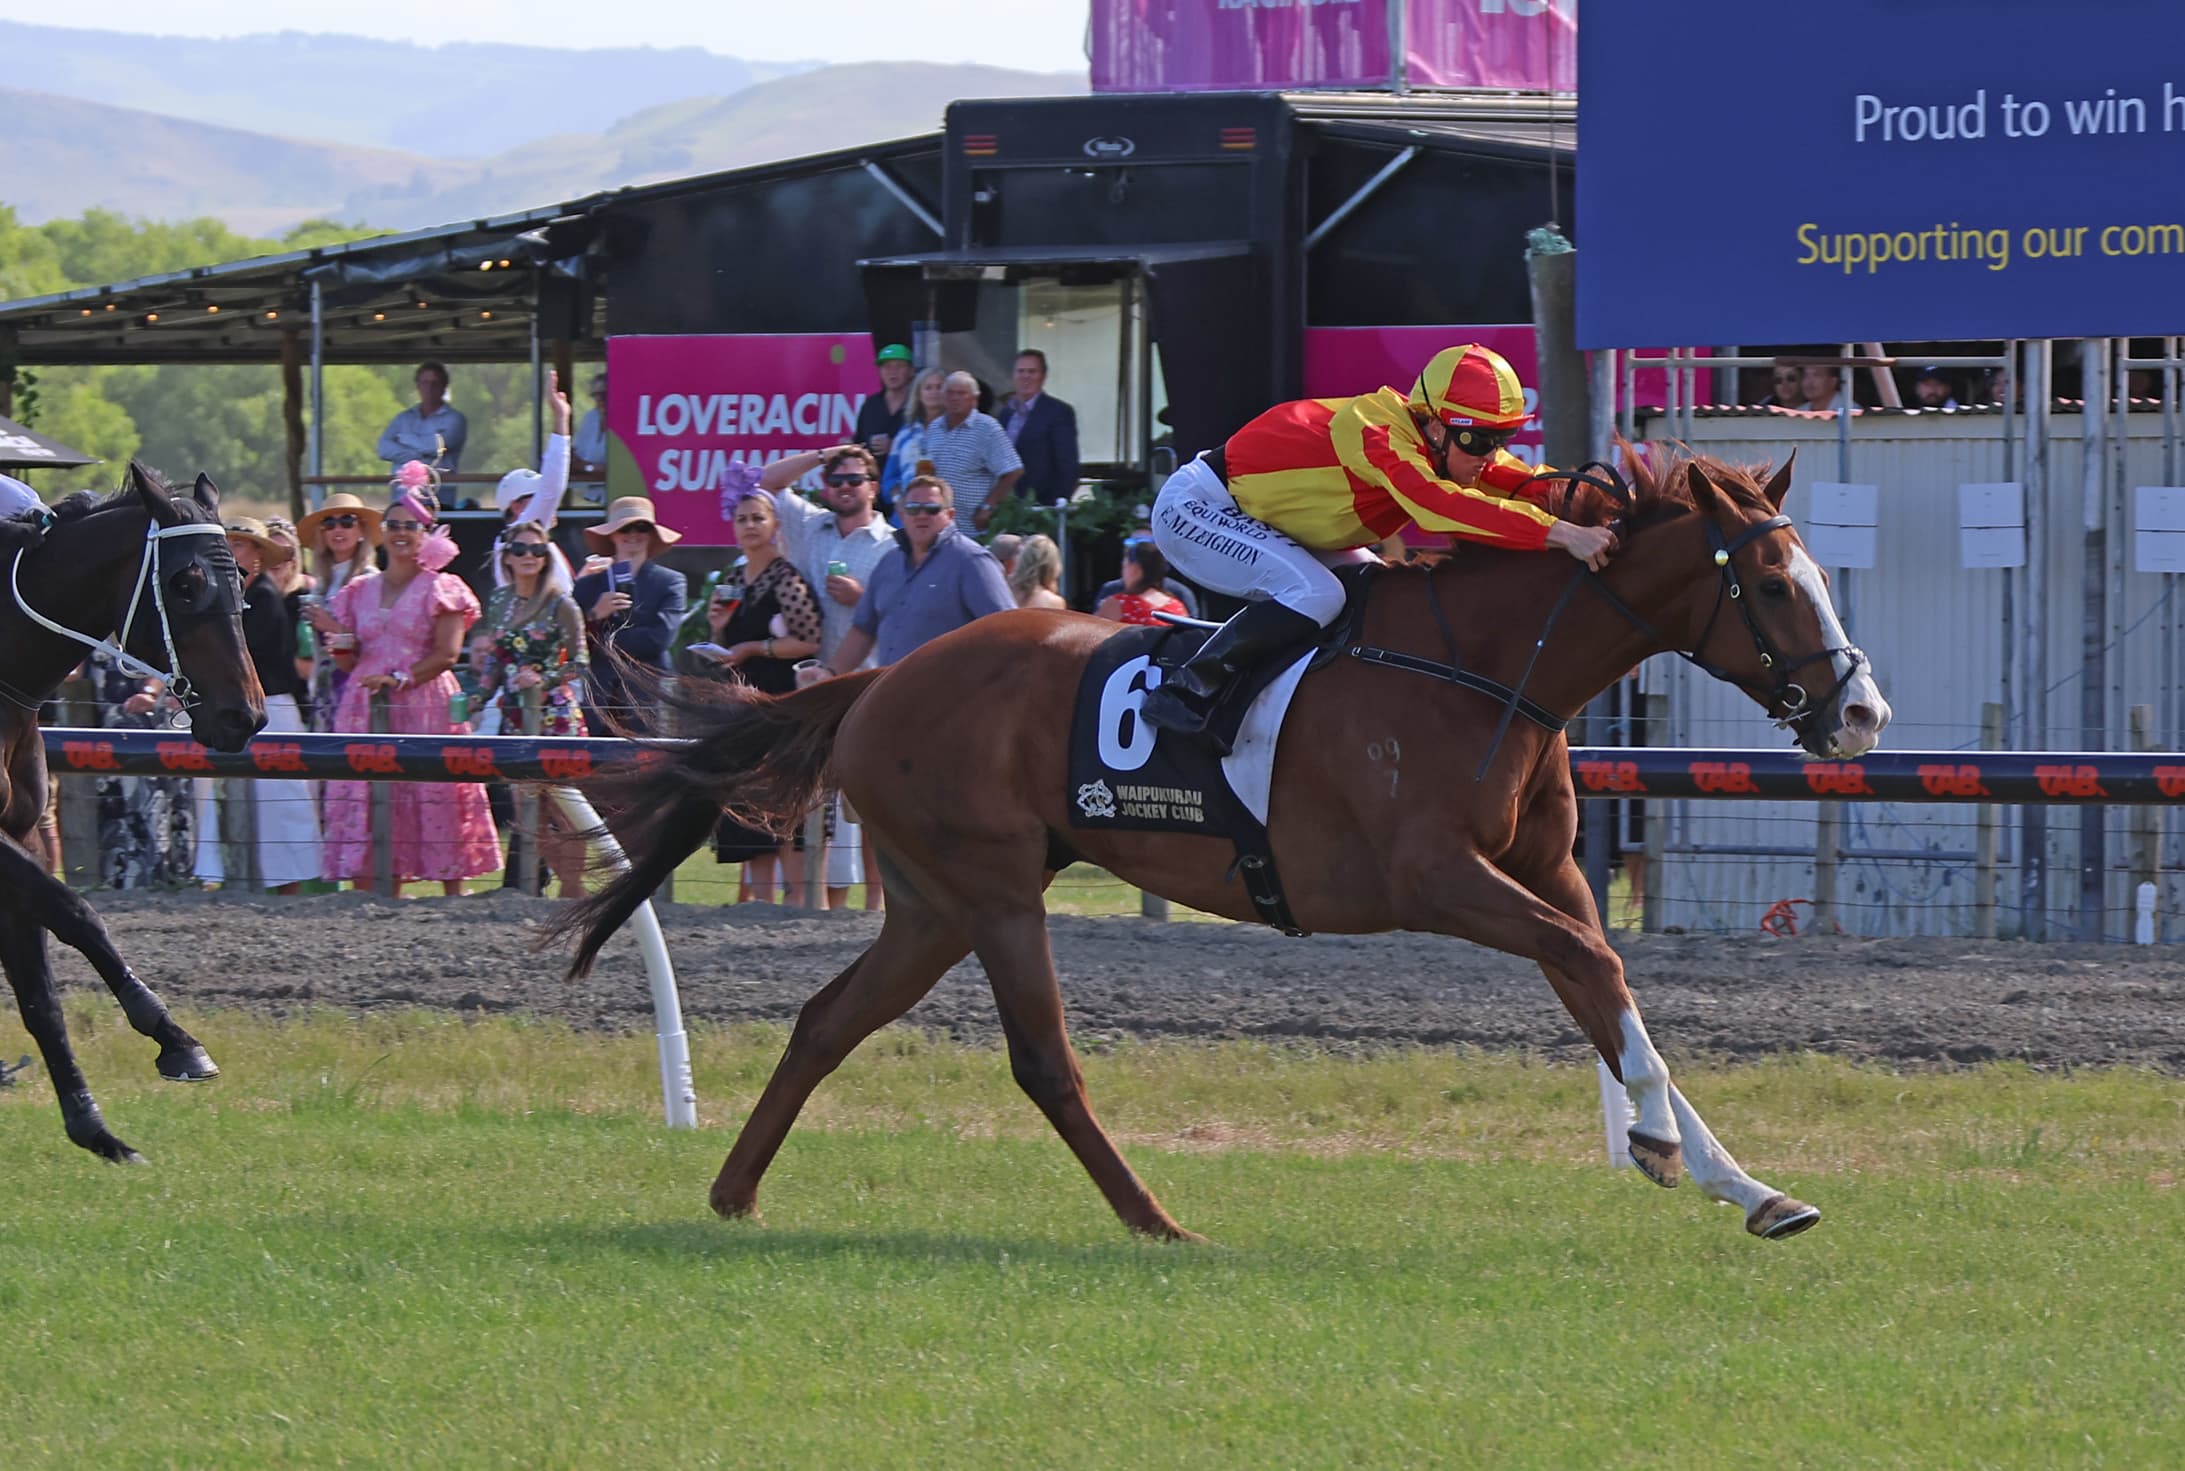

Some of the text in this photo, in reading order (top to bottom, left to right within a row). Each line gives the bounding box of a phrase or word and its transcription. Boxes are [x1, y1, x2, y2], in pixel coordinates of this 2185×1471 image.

[1854, 88, 1987, 143] Proud
[2001, 93, 2051, 138] to
[2064, 88, 2147, 135] win
[1796, 221, 2185, 275] Supporting our com
[1184, 498, 1269, 541] EQUIWORLD
[1098, 654, 1162, 771] 6
[344, 744, 404, 773] TAB
[442, 746, 502, 776] TAB
[1576, 761, 1648, 792] TAB
[1688, 762, 1760, 793] TAB
[1802, 763, 1875, 794] TAB
[1916, 764, 1993, 796] TAB
[2033, 765, 2110, 797] TAB
[1116, 785, 1203, 806] WAIPUKURAU
[1121, 802, 1205, 823] JOCKEY CLUB
